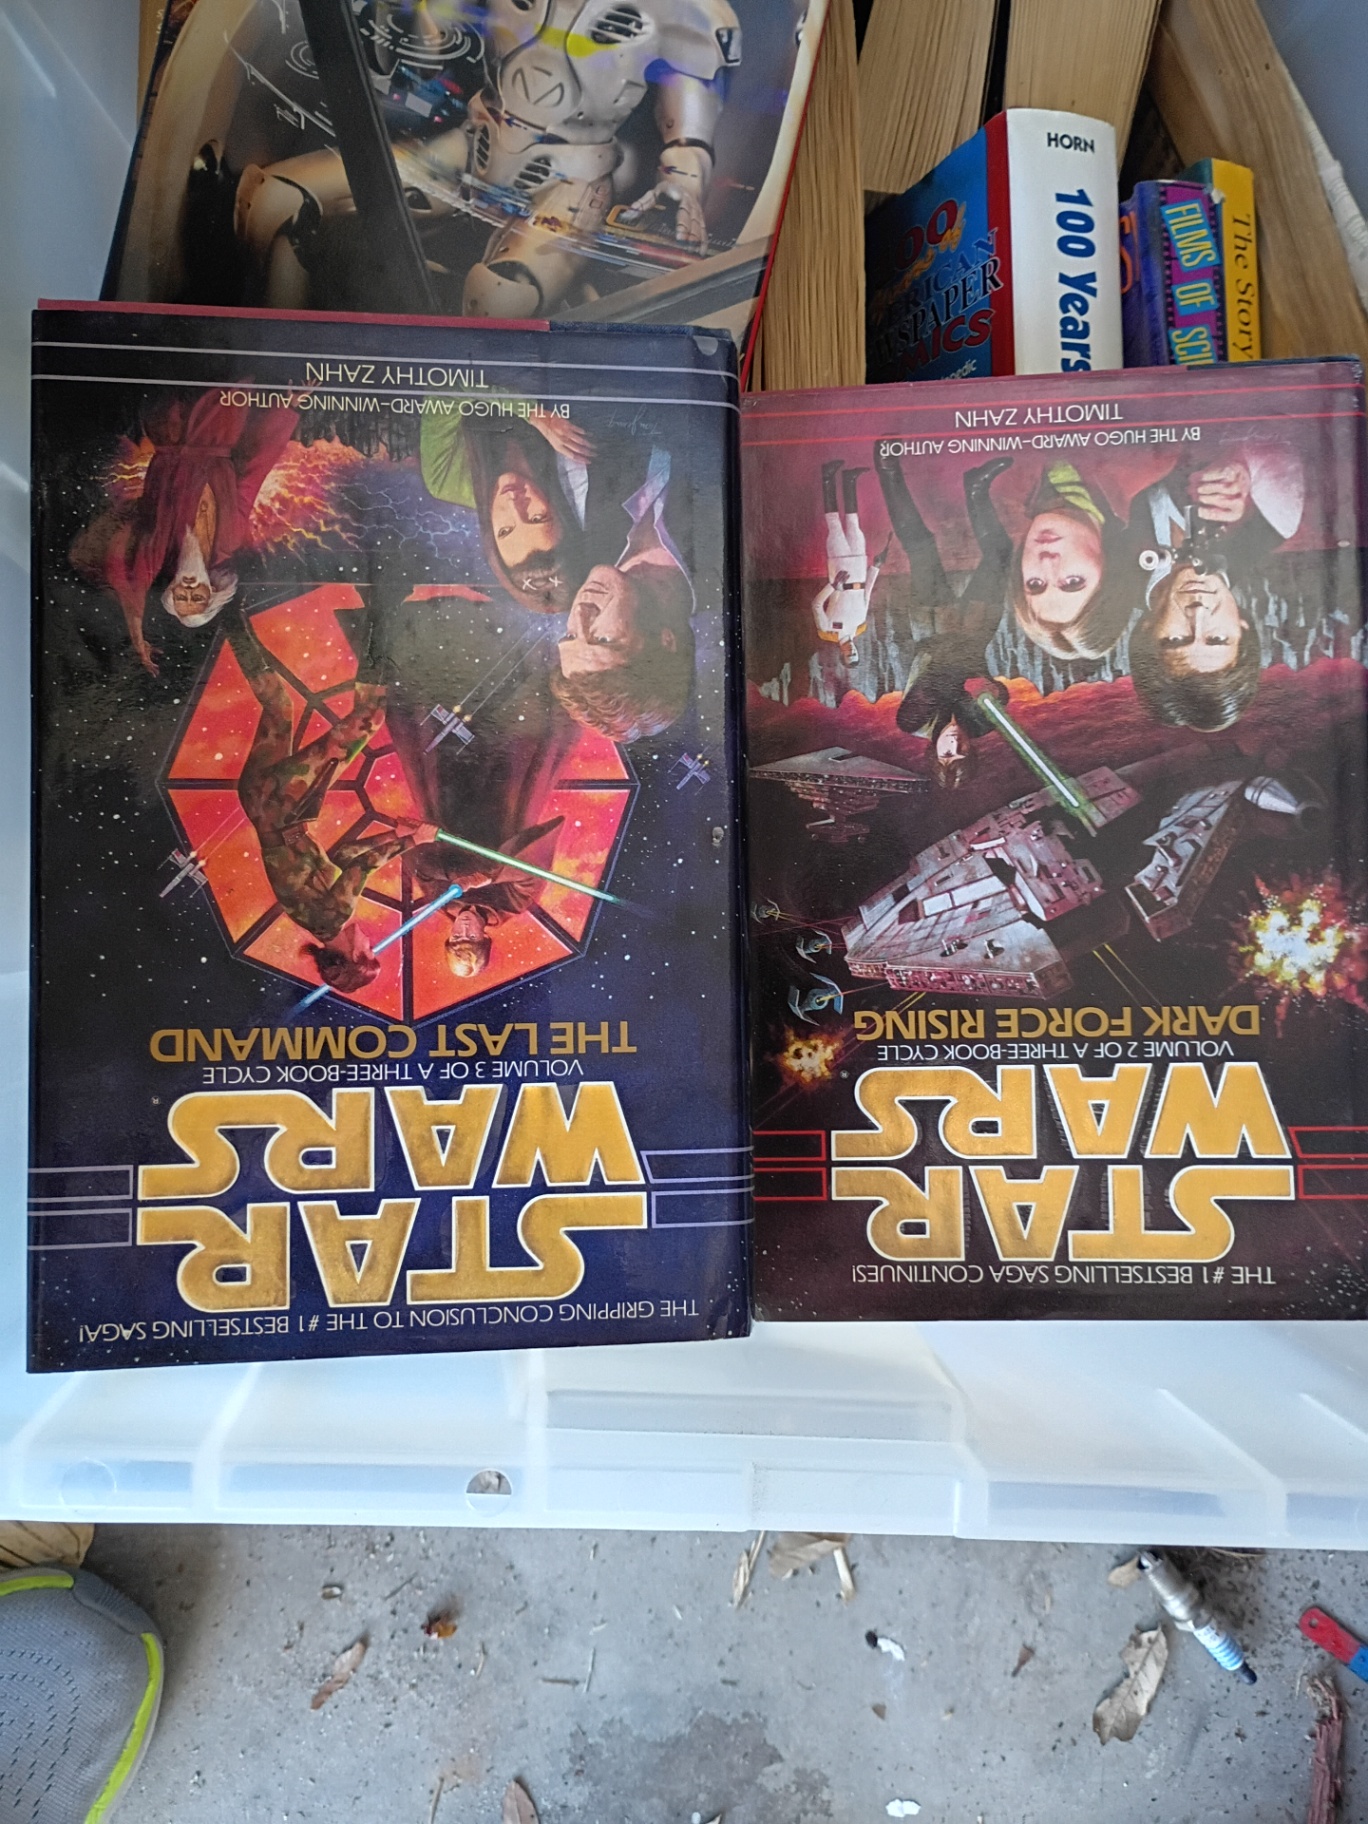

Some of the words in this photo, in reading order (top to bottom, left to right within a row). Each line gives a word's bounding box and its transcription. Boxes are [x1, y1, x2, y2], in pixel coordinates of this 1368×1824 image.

[1046, 132, 1095, 154] HORN
[1055, 188, 1096, 258] 100
[1165, 202, 1217, 268] FILMS
[1232, 213, 1253, 270] The
[1175, 282, 1215, 308] OF
[1232, 278, 1255, 360] Story
[306, 362, 375, 384] ZAHN
[382, 366, 489, 388] TIMOTHY
[219, 391, 293, 408] AUTHOR
[297, 394, 455, 415] AWARD-WINNING
[459, 401, 513, 417] HUGO
[518, 402, 546, 418] THE
[550, 403, 570, 419] BY
[955, 408, 1018, 428] ZAHN
[1023, 403, 1124, 424] TIMOTHY
[948, 432, 1091, 454] AWARD-WINNING
[1094, 429, 1146, 446] HUGO
[1150, 428, 1178, 443] THE
[1181, 426, 1200, 441] BY
[879, 440, 944, 457] AUTHOR
[853, 1009, 985, 1041] RISING
[995, 1006, 1132, 1039] FORCE
[1141, 1005, 1260, 1036] DARK
[150, 1024, 417, 1062] COMMAND
[429, 1022, 538, 1057] LAST
[550, 1021, 637, 1054] THE
[877, 1045, 939, 1061] CYCLE
[942, 1043, 1069, 1061] THREE-BOOK
[1073, 1043, 1089, 1058] A
[1094, 1042, 1122, 1058] OF
[1127, 1042, 1138, 1058] 2
[1143, 1040, 1235, 1057] VOLUME
[202, 1066, 271, 1084] CYCLE
[276, 1063, 413, 1083] THREE-BOOK
[417, 1063, 434, 1079] A
[440, 1061, 469, 1079] OF
[475, 1061, 486, 1078] 3
[492, 1059, 584, 1078] VOLUME
[831, 1062, 1293, 1161] WARS
[138, 1081, 645, 1200] WARS
[831, 1165, 1296, 1263] STAR
[137, 1192, 648, 1313] STAR
[852, 1265, 984, 1283] CONTINUES!
[989, 1265, 1049, 1283] SAGA
[1054, 1265, 1193, 1285] BESTSELLING
[1231, 1266, 1276, 1285] THE
[410, 1304, 553, 1327] CONCLUSION
[559, 1301, 655, 1321] GRIPPING
[660, 1299, 699, 1317] THE
[152, 1316, 289, 1339] BESTSELLING
[326, 1312, 368, 1331] THE
[374, 1311, 404, 1328] TO
[79, 1322, 146, 1343] SAGA!
